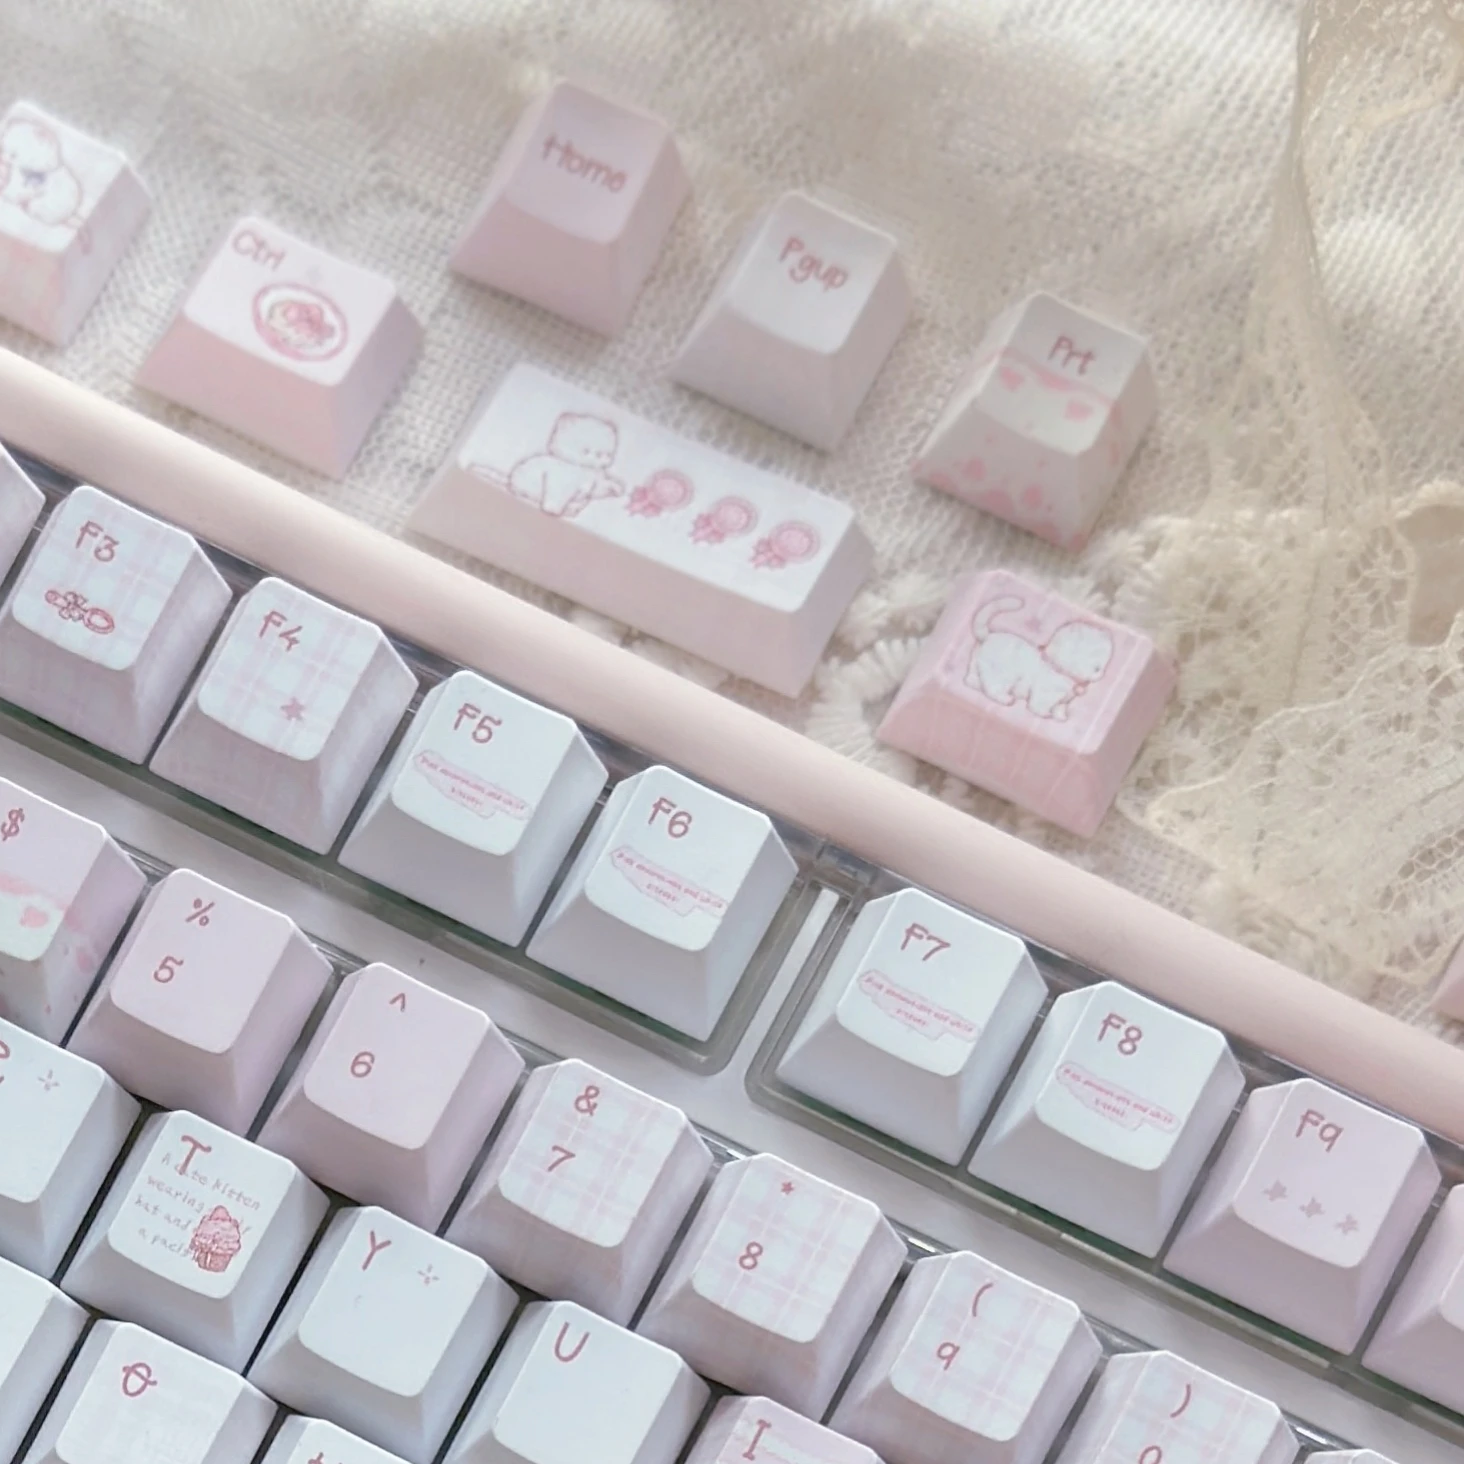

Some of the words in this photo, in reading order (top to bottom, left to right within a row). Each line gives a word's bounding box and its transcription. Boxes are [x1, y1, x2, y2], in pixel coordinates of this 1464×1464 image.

[542, 134, 627, 193] Home
[231, 228, 287, 271] Ctrl
[778, 236, 850, 290] Pgup
[1050, 335, 1095, 374] Prt
[75, 521, 118, 563] F3
[258, 610, 303, 651] F4
[453, 702, 502, 744] F5
[0, 807, 25, 841] $
[648, 795, 693, 838] F6
[185, 898, 215, 927] %
[900, 922, 951, 962] F7
[153, 955, 184, 984] 5
[1097, 1012, 1143, 1055] F8
[349, 1052, 375, 1078] 6
[573, 1085, 600, 1116] &
[180, 1135, 212, 1175] T
[548, 1145, 575, 1172] 7
[361, 1230, 391, 1271] Y
[739, 1242, 763, 1270] 8
[971, 1282, 994, 1317] (
[554, 1322, 590, 1363] U
[1170, 1384, 1192, 1418] )
[743, 1420, 770, 1461] I
